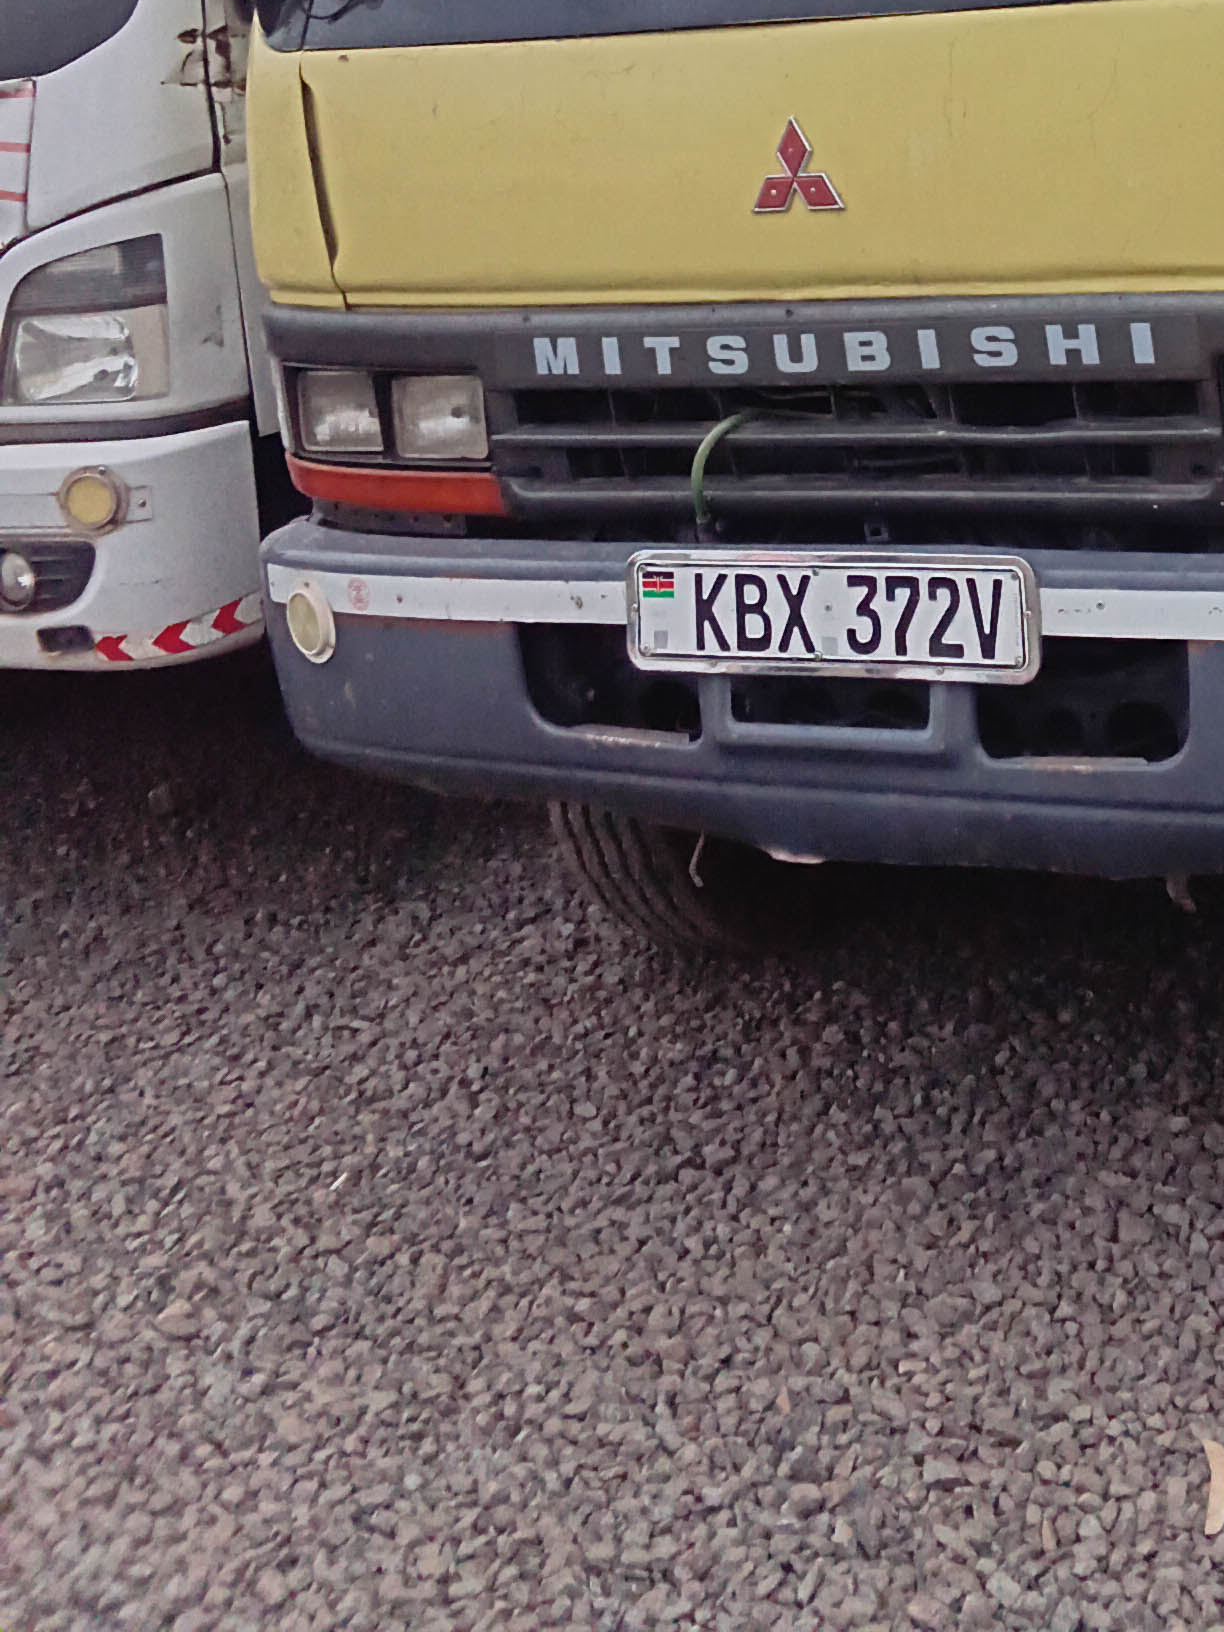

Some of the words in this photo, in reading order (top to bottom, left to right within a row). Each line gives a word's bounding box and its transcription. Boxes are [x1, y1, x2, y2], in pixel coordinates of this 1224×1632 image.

[532, 322, 1156, 375] MITSUBISHI
[693, 572, 817, 654] KBX
[845, 574, 1004, 660] 372V
